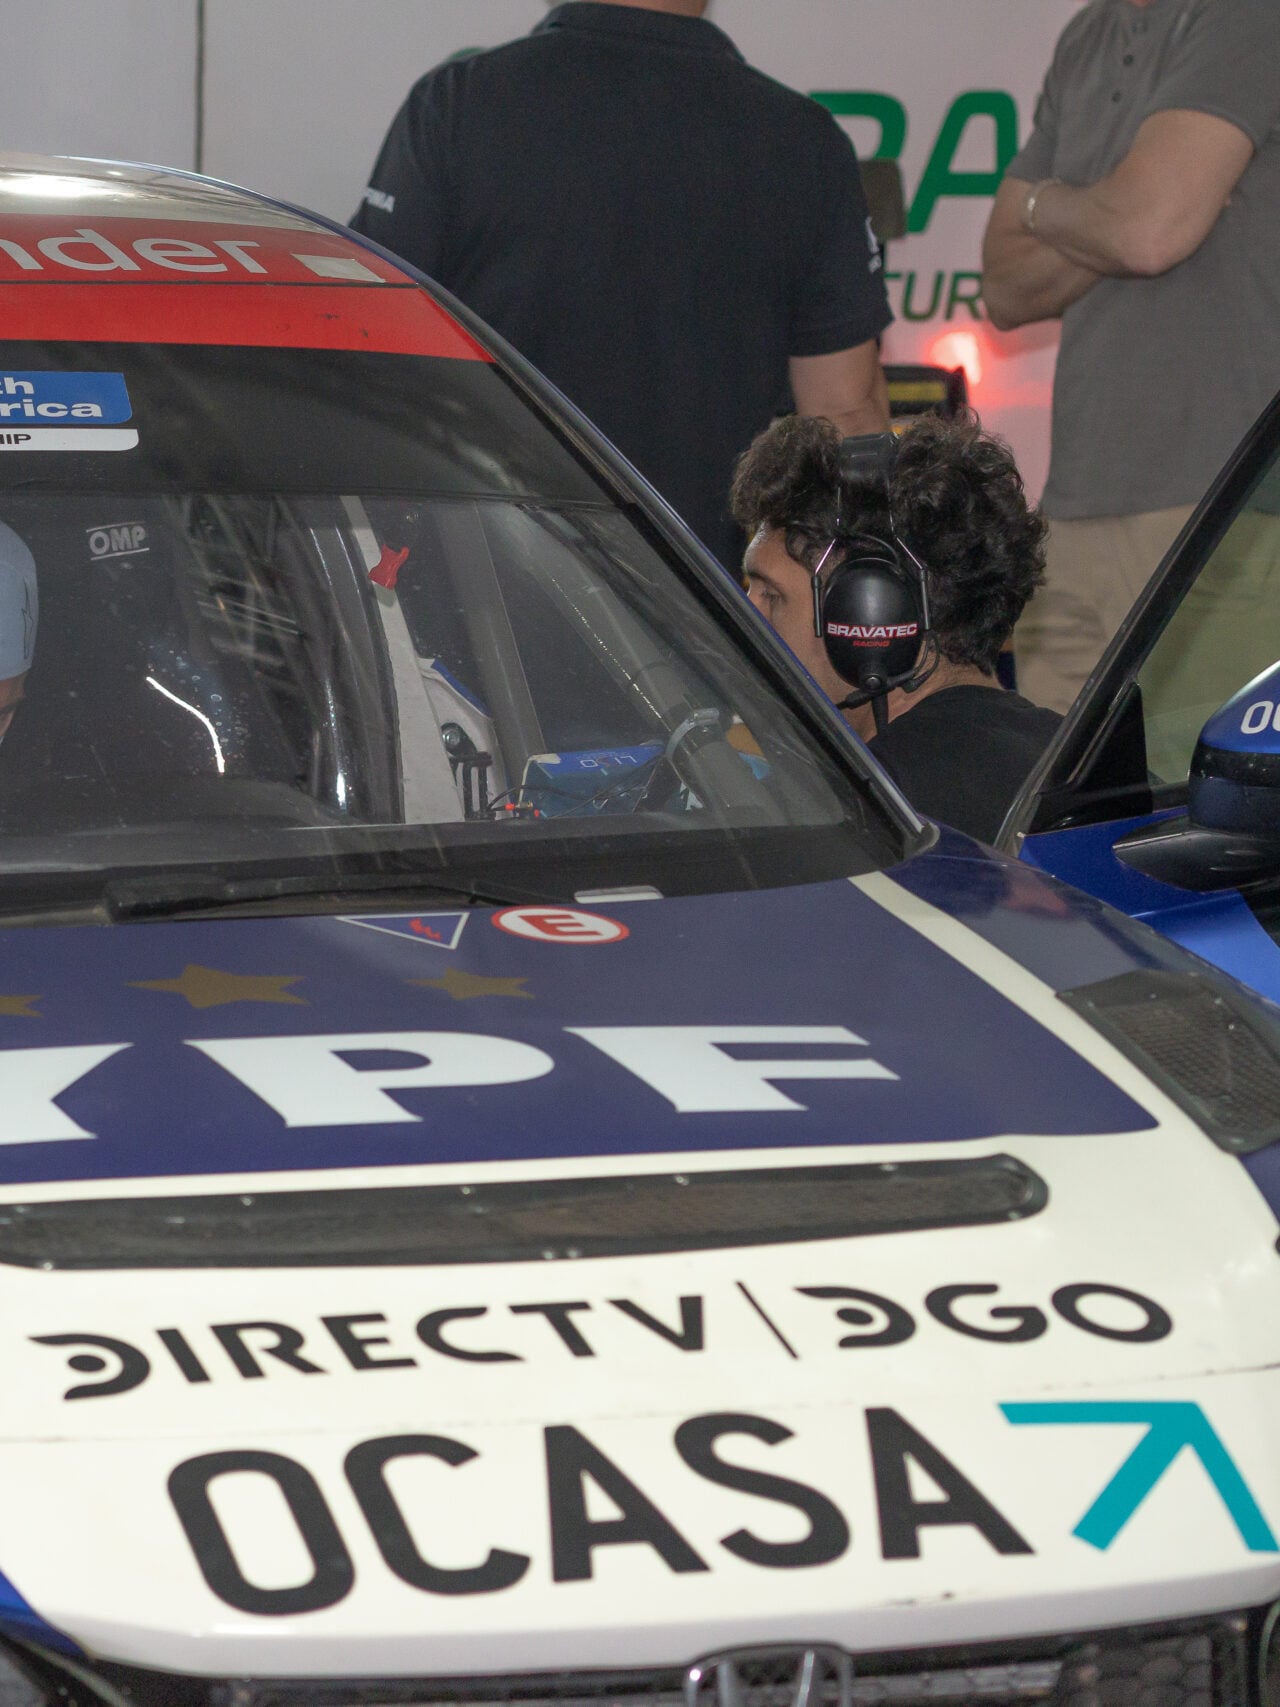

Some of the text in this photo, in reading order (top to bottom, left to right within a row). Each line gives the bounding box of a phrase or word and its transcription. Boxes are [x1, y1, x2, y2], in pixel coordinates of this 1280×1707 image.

[89, 525, 146, 555] OMP
[827, 623, 918, 638] BRAVATEC
[852, 640, 891, 648] RACING
[29, 1294, 704, 1400] DIRECTV
[166, 1406, 1036, 1617] OCASA
